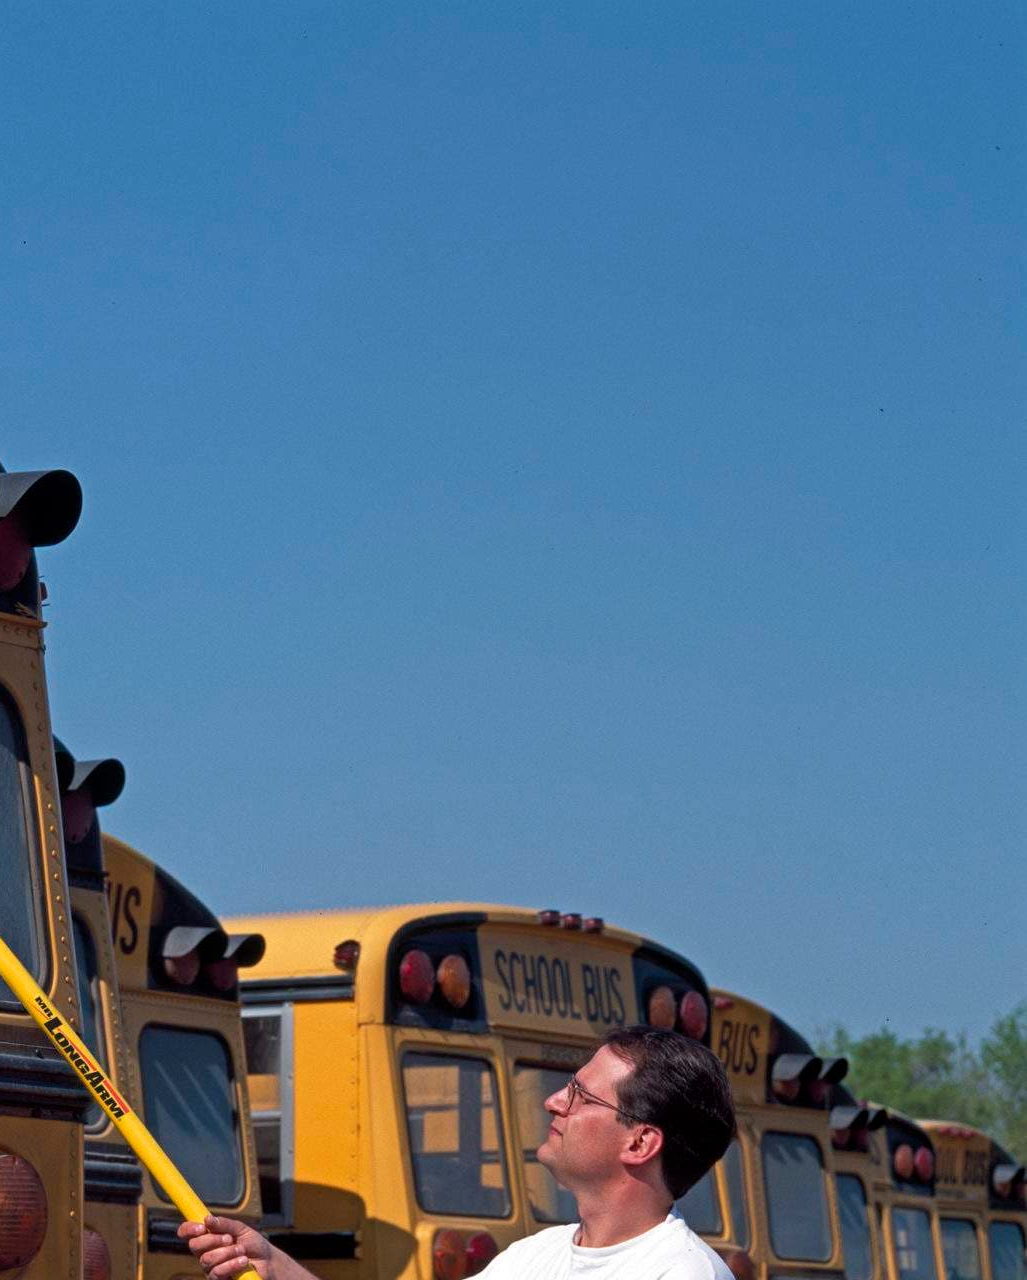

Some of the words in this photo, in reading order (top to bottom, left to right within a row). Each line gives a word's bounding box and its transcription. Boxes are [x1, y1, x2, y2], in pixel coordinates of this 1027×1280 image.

[494, 949, 582, 1021] SCHOOL
[581, 963, 626, 1025] BUS
[719, 1020, 760, 1076] BUS
